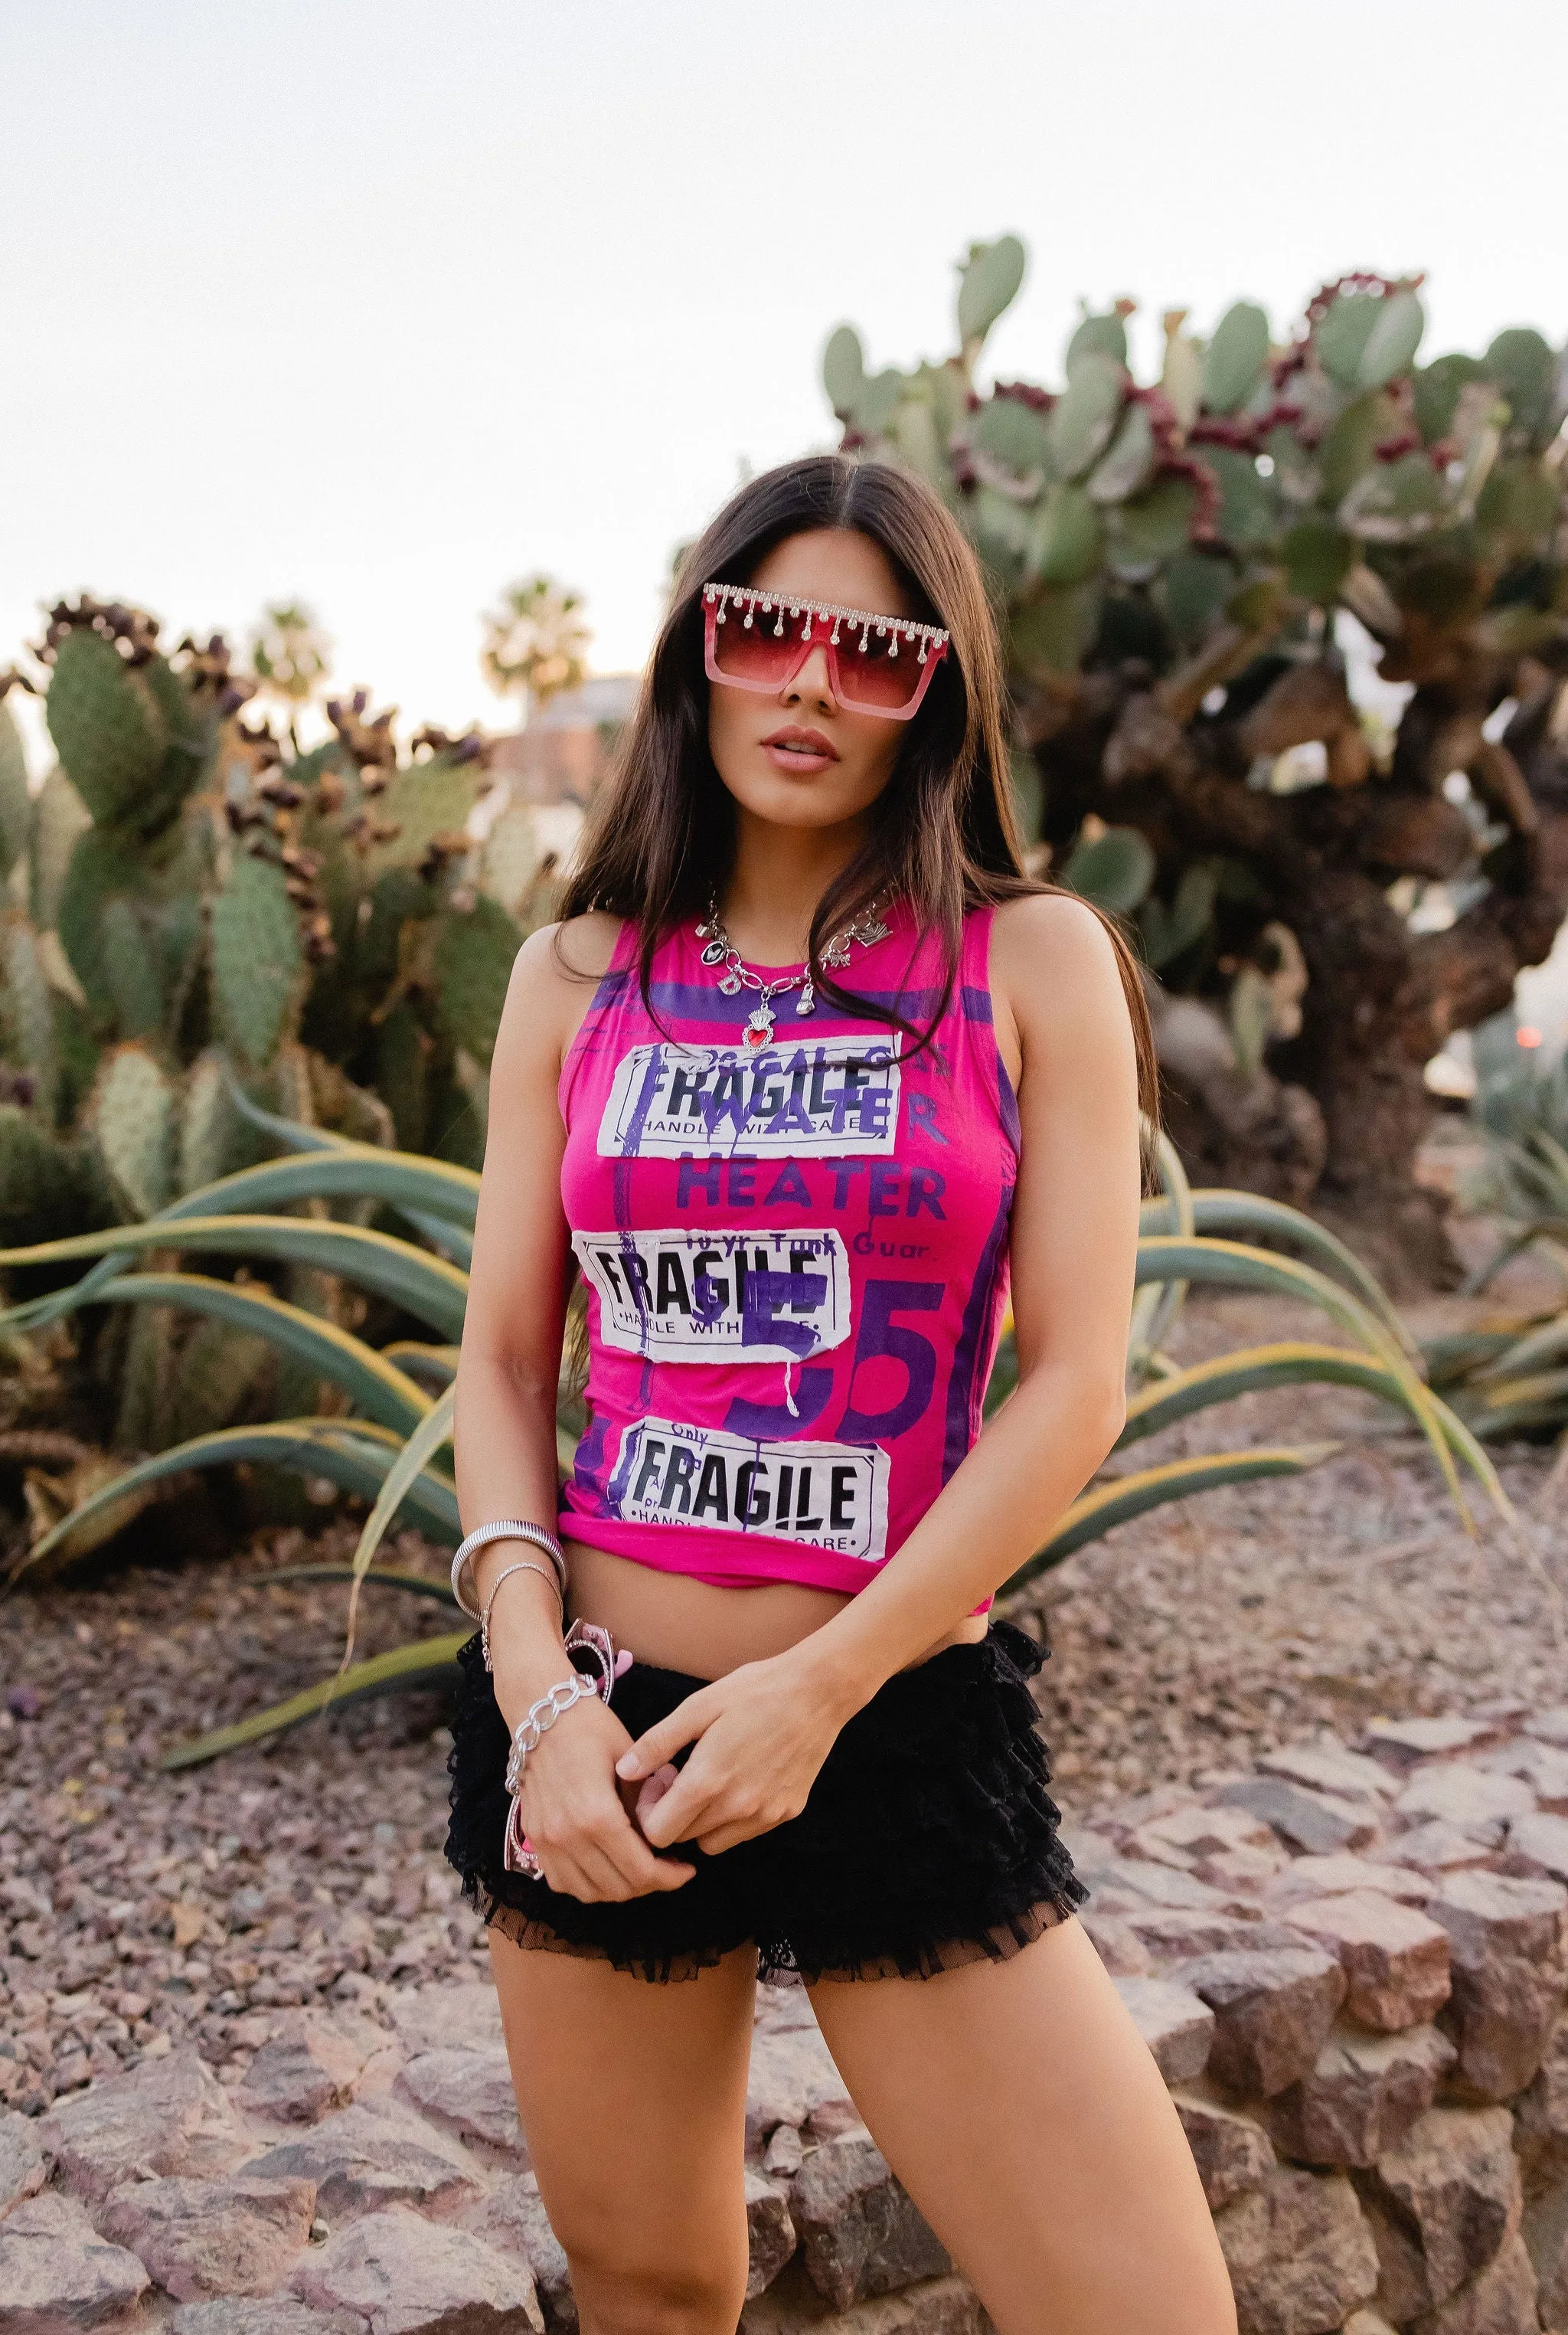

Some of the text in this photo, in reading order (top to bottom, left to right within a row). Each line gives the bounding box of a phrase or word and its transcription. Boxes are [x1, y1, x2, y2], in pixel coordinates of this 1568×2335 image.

[634, 1056, 871, 1117] FRAGILE
[698, 1087, 949, 1146] WATER
[677, 1151, 946, 1221] HEATER
[769, 1234, 837, 1256] Tank
[599, 1251, 817, 1315] FRAGILE
[689, 1321, 739, 1334] WITH
[671, 1424, 708, 1450] Only
[632, 1439, 858, 1530] FRAGILE
